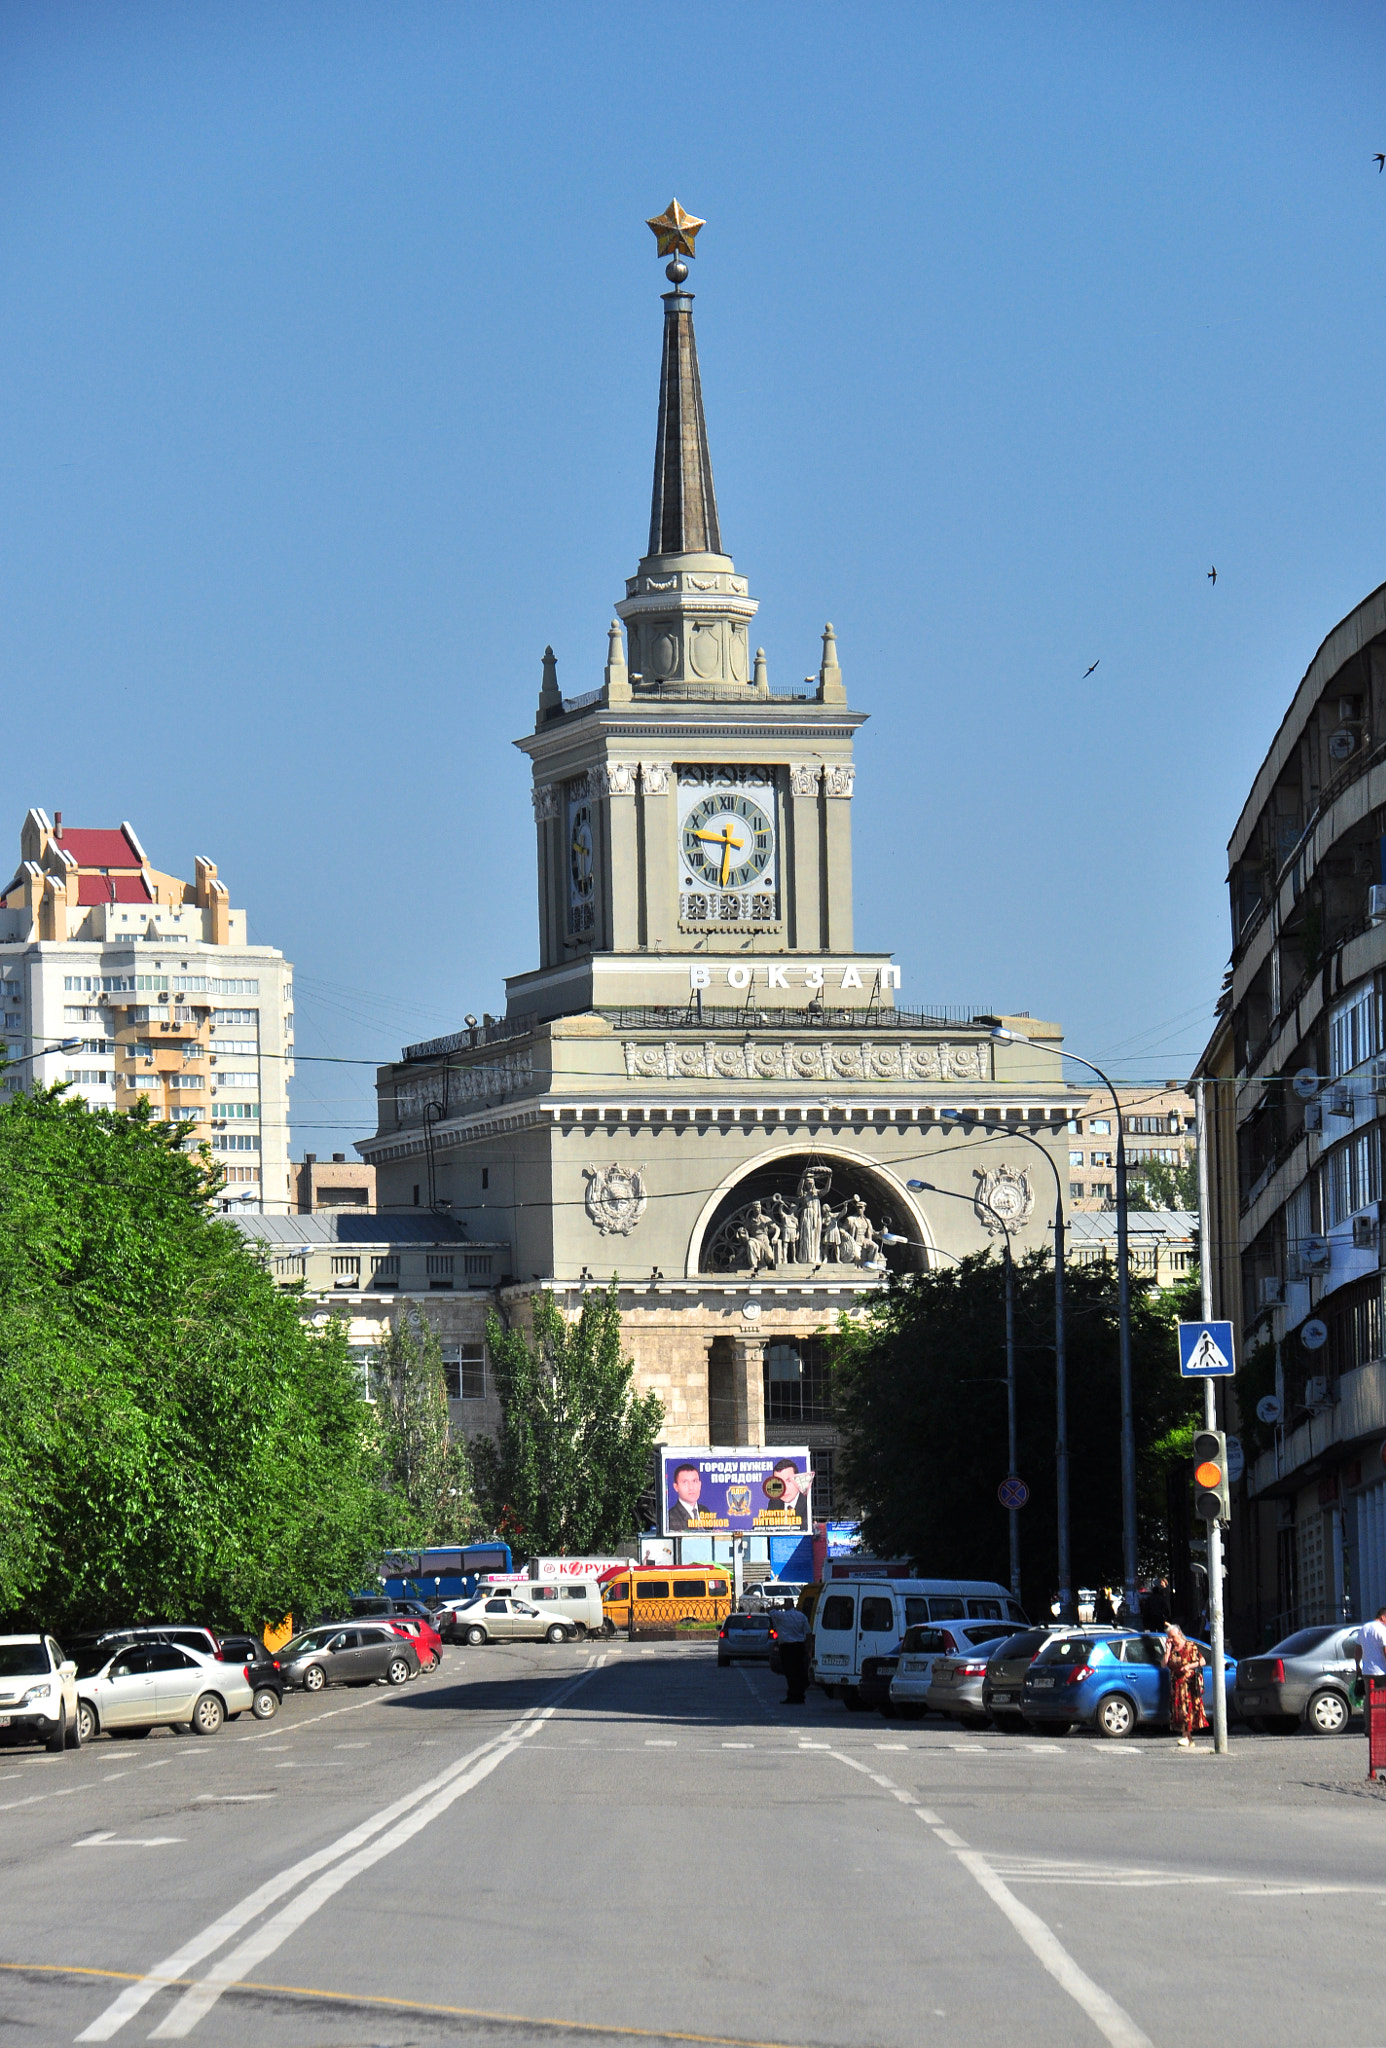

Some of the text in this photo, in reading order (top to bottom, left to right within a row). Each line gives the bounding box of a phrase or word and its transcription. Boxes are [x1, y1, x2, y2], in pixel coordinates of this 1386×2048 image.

[690, 964, 902, 989] ВОКЗАЛ
[699, 1461, 774, 1474] ГОРОДУ НУЖЕН
[711, 1472, 762, 1484] ПОРЯДОК!
